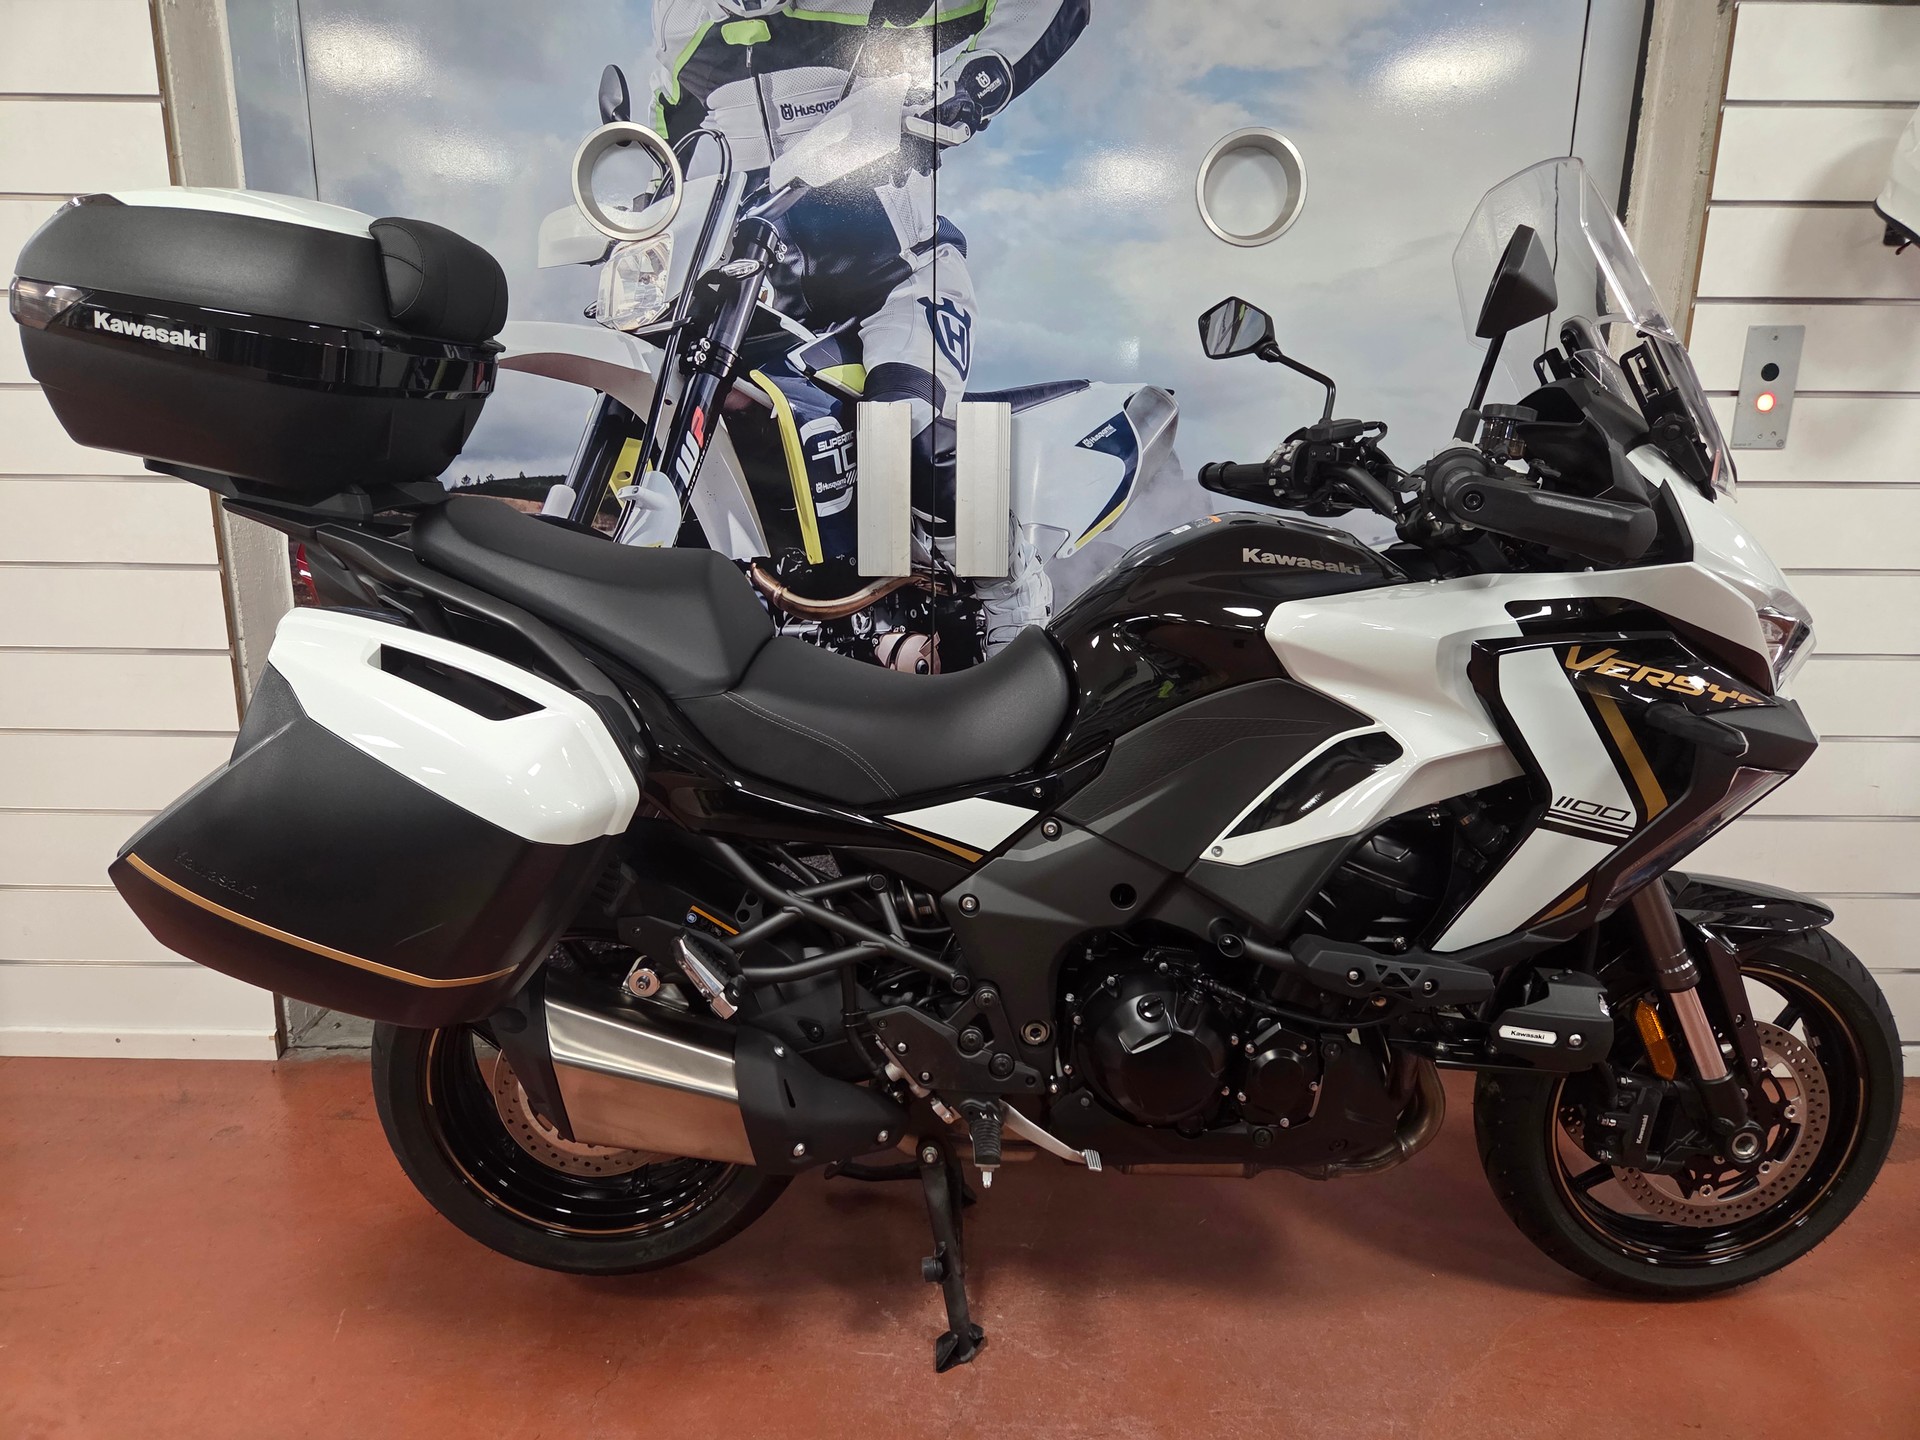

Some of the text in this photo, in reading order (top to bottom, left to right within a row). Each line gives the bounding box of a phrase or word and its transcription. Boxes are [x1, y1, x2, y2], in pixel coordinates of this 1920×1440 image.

[93, 310, 207, 351] Kawasaki
[1242, 547, 1362, 576] Kawasaki
[1554, 795, 1631, 822] 1100
[1510, 1030, 1545, 1040] Kawasaki
